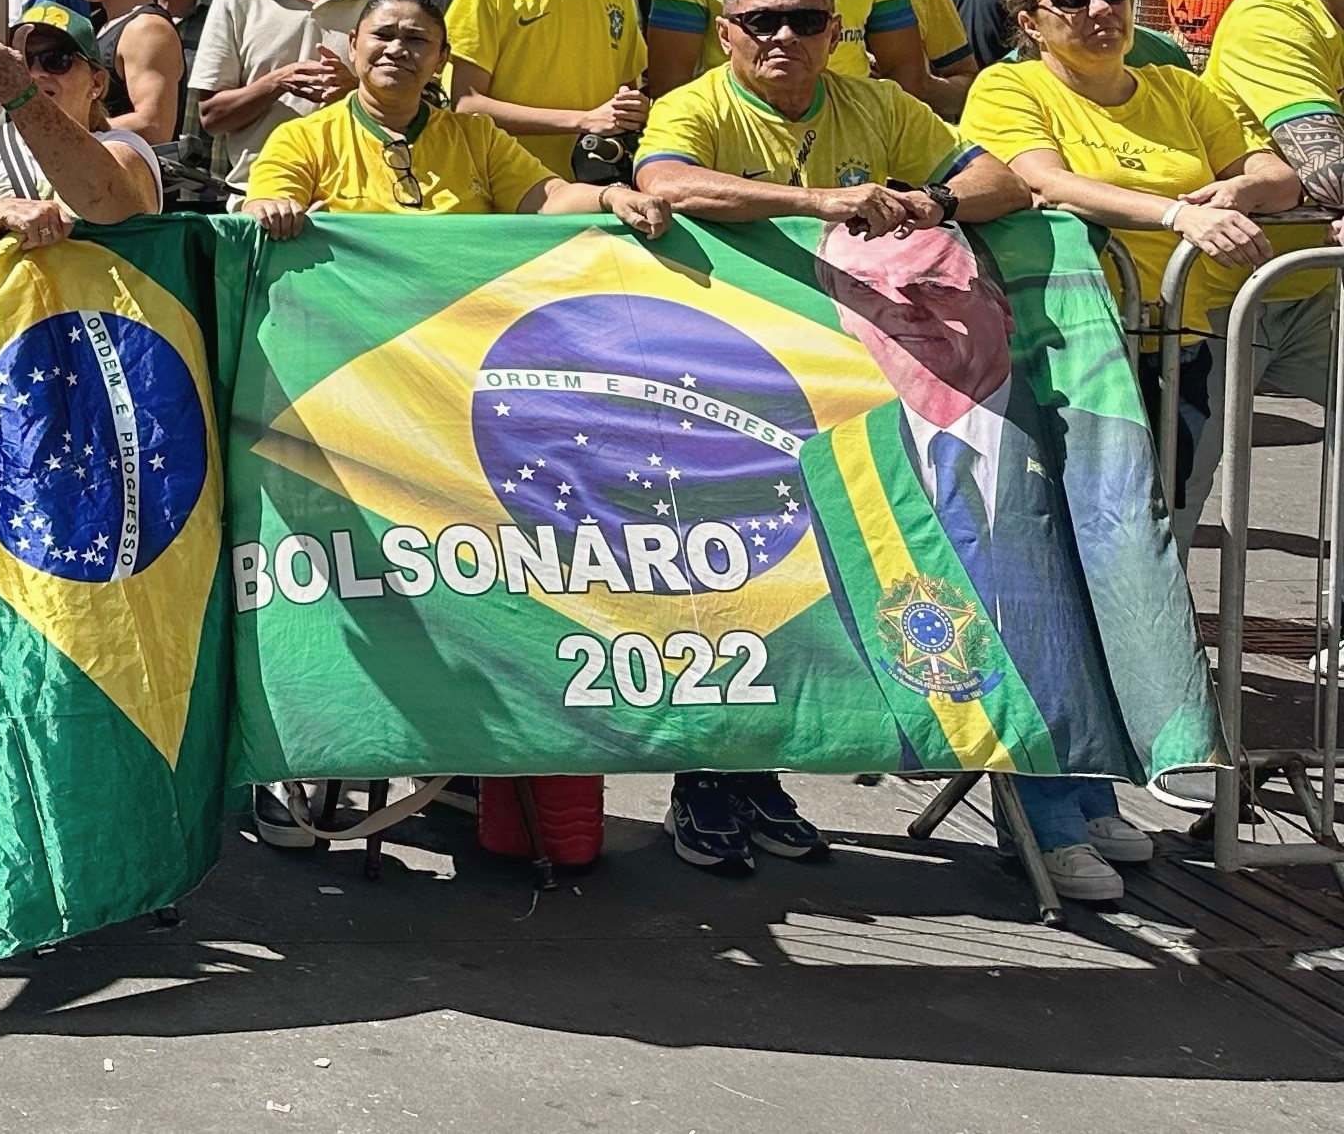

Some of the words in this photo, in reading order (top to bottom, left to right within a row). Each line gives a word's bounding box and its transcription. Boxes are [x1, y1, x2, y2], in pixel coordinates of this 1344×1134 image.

[86, 317, 122, 388] ORDEM
[486, 372, 582, 389] ORDEM
[607, 378, 619, 392] E
[115, 403, 129, 415] E
[119, 431, 136, 567] PROGRESSO
[232, 522, 750, 613] BOLSONARO
[555, 630, 778, 708] 2022
